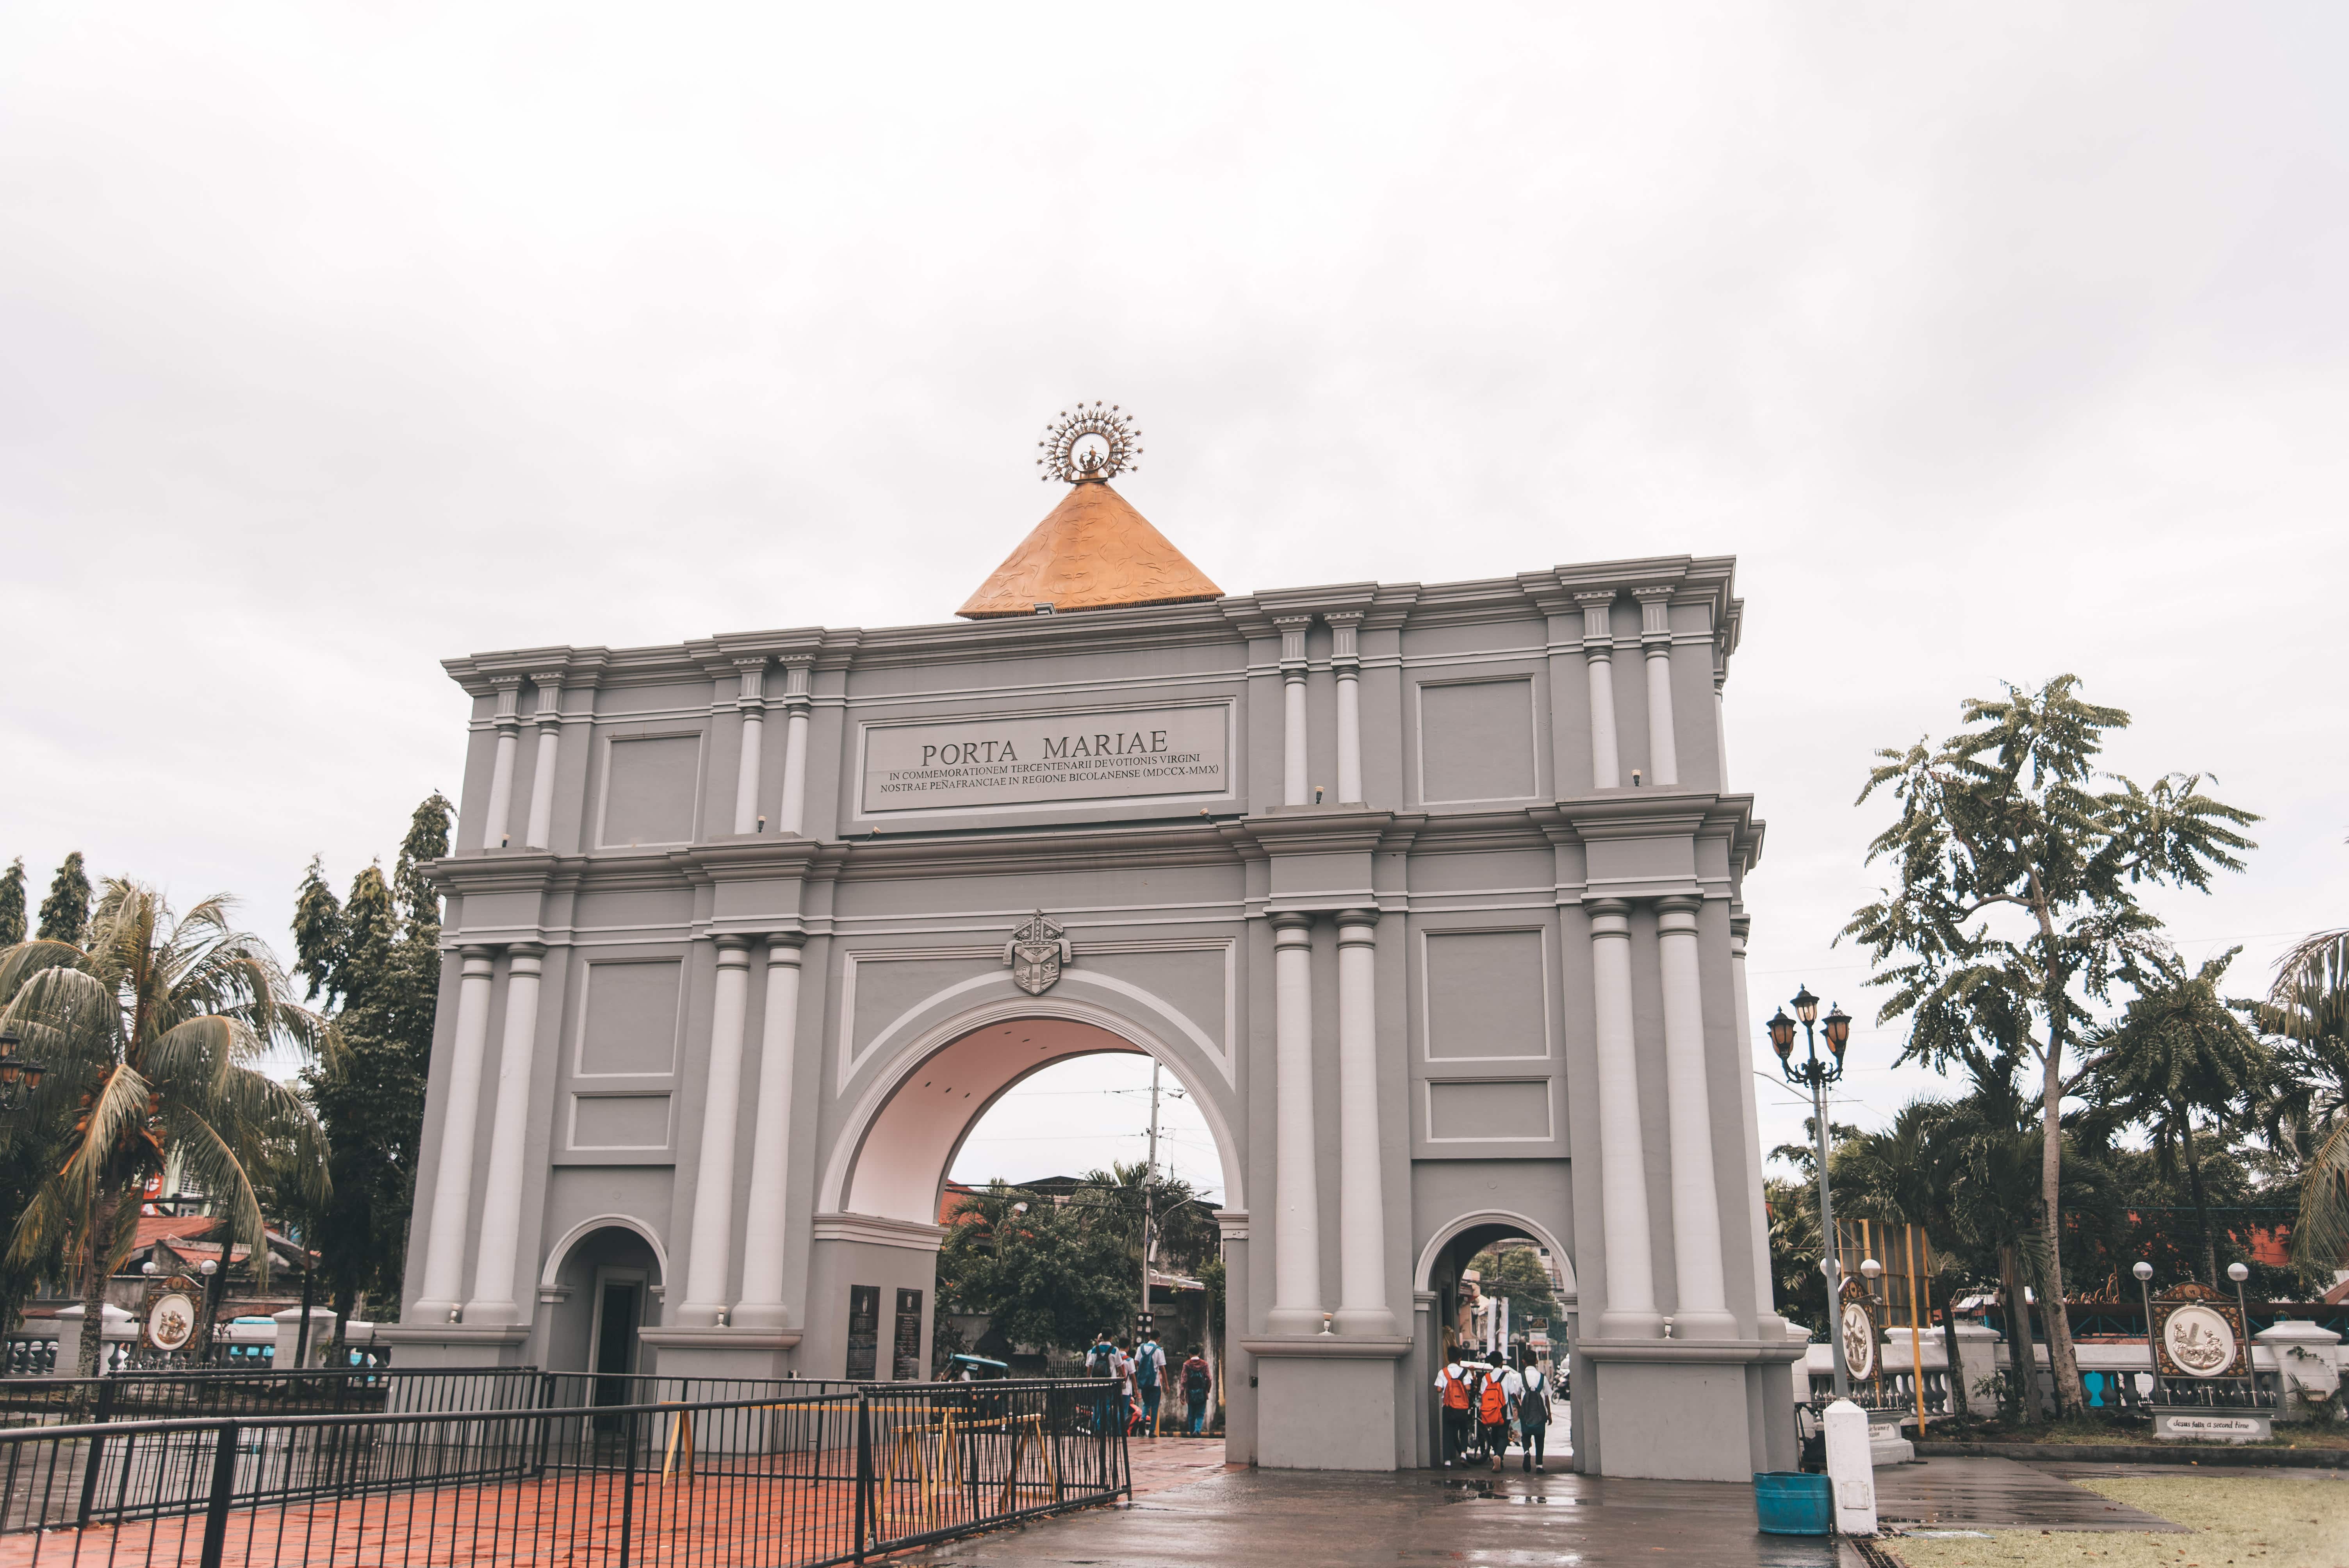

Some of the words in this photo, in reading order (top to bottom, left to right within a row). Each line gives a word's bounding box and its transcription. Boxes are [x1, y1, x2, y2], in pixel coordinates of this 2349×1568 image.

[921, 740, 1018, 766] PORTA
[1042, 731, 1168, 760] MARIAE
[880, 782, 927, 793] NOSTRAE
[930, 777, 1006, 790] PEÑAFRANCIAE
[1009, 777, 1019, 785] IN
[1022, 774, 1066, 784] REGIONE
[1069, 770, 1141, 781] BICOLANENSE
[1143, 764, 1219, 777] (MDCCX-MMX)
[889, 772, 900, 780] IN
[902, 766, 1008, 780] COMMEMORATIONEM
[1011, 760, 1091, 773] TERCENTENARII
[1094, 756, 1157, 768] DEVOTIONIS
[1160, 754, 1200, 764] VIRGINI
[2235, 1421, 2249, 1429] time
